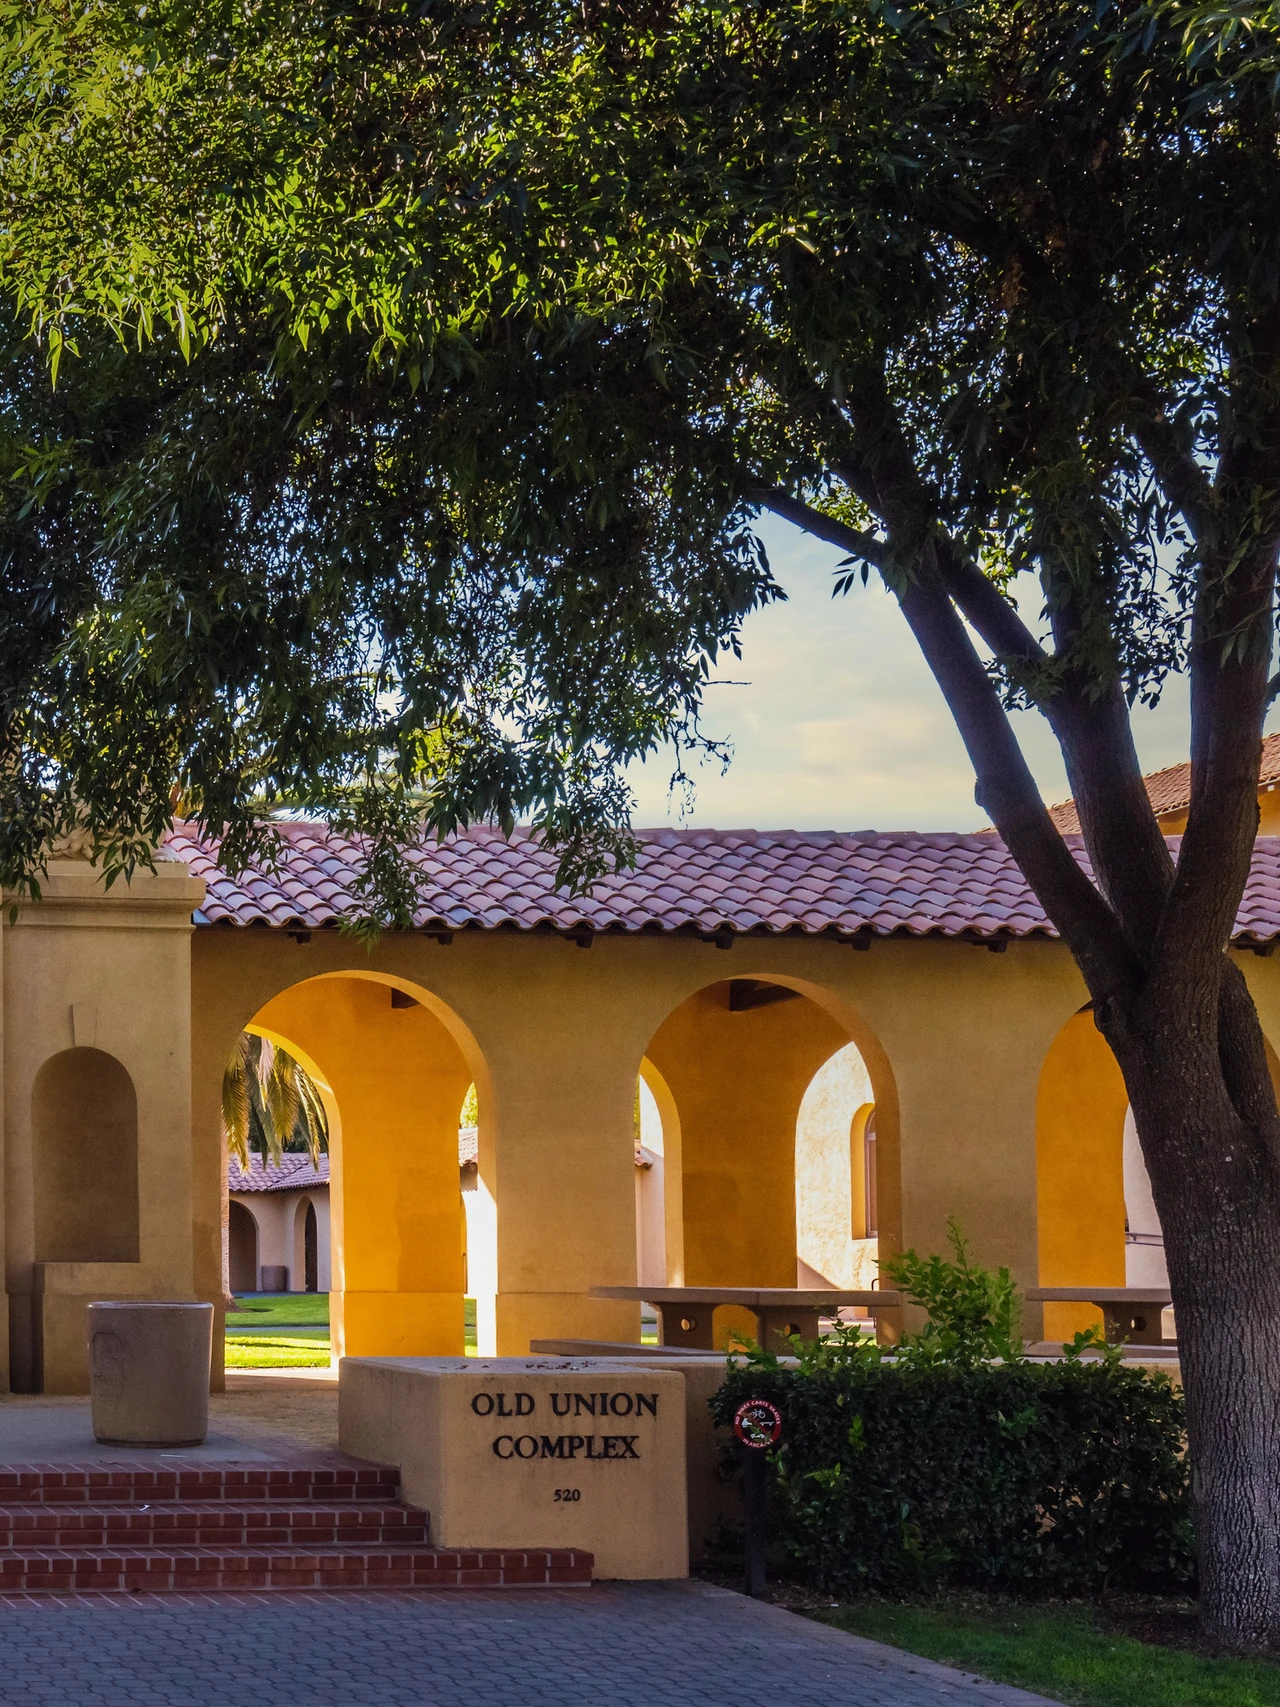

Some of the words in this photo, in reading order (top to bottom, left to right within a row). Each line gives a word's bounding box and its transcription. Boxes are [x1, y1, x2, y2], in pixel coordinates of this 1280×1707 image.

[471, 1393, 535, 1416] OLD
[550, 1393, 659, 1416] UNION
[769, 1405, 781, 1424] SKATES
[493, 1435, 640, 1459] COMPLEX
[553, 1489, 581, 1502] 520
